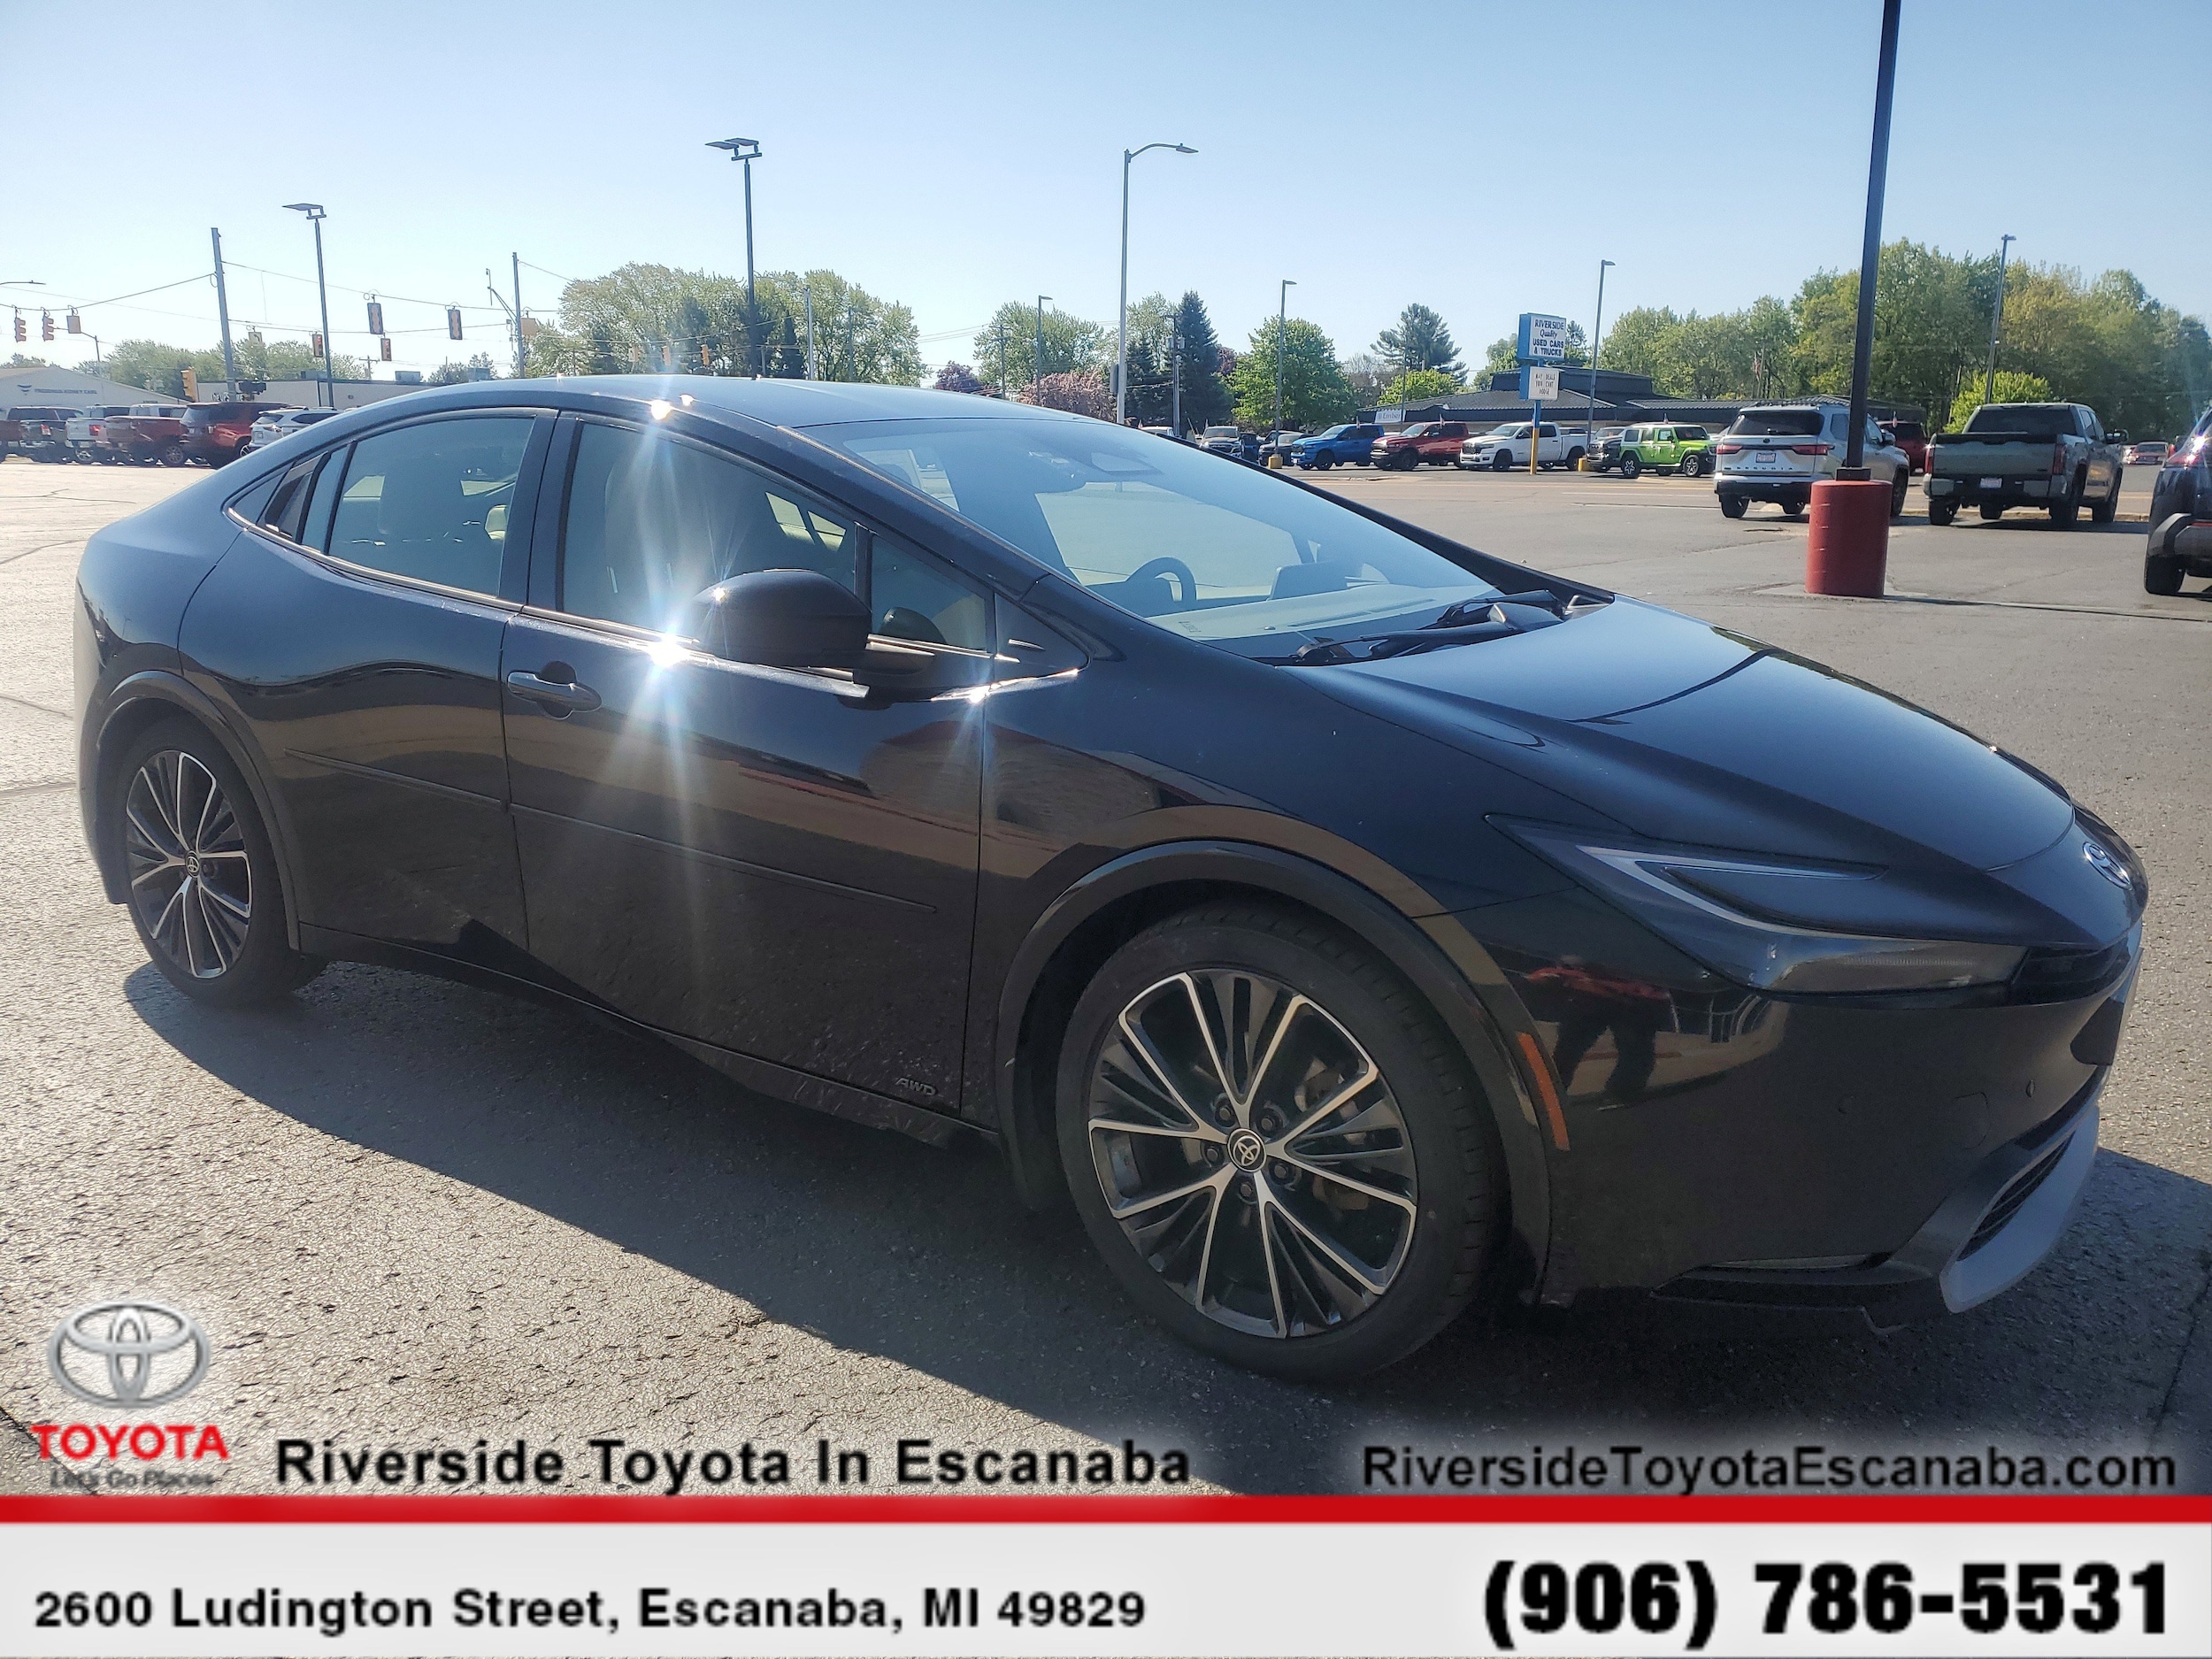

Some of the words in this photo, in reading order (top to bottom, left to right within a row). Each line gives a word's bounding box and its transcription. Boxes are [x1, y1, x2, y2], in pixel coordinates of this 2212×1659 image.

[1534, 319, 1564, 330] RIVERSIDE
[1540, 329, 1557, 339] Quality
[1532, 338, 1548, 347] USED
[1549, 340, 1564, 349] CARS
[1540, 347, 1563, 357] TRUCKS
[895, 1078, 936, 1095] AWD
